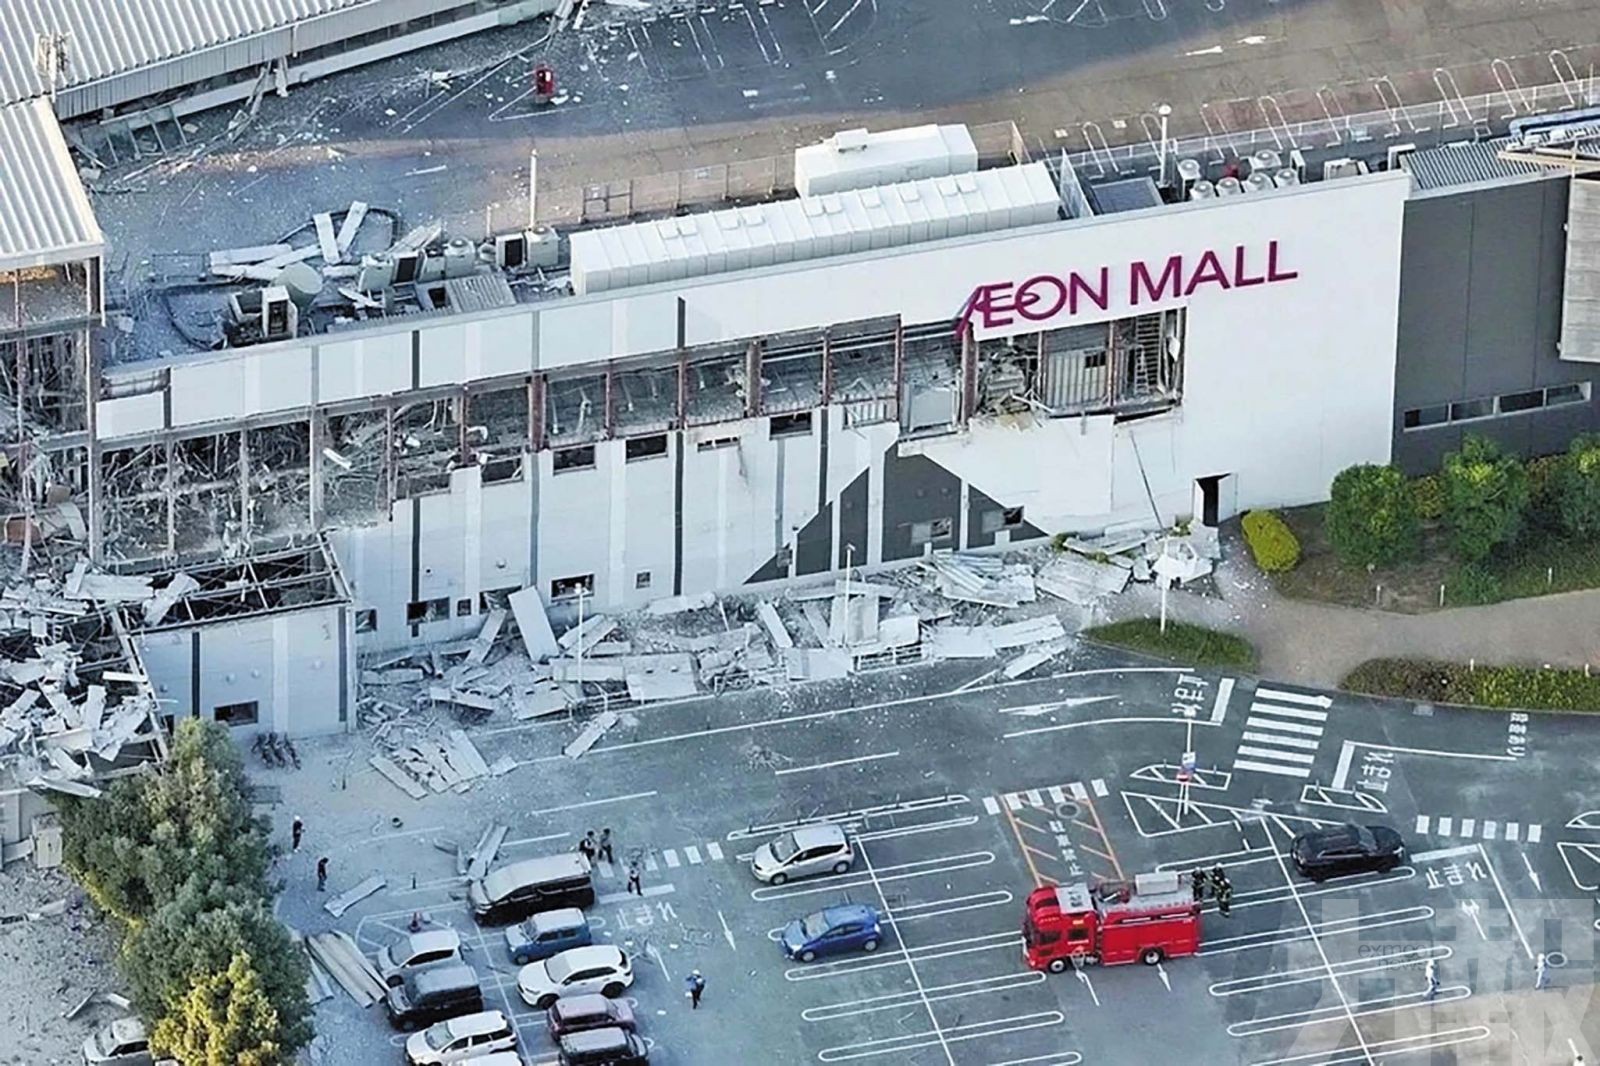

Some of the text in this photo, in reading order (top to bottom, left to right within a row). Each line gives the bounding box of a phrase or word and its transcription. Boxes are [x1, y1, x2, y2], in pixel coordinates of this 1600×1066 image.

[1130, 240, 1299, 306] MALL
[1355, 751, 1395, 793] 止まれ
[1048, 820, 1084, 876] 駐車禁止
[1425, 860, 1488, 890] 止まれ
[615, 900, 678, 930] 止まれ
